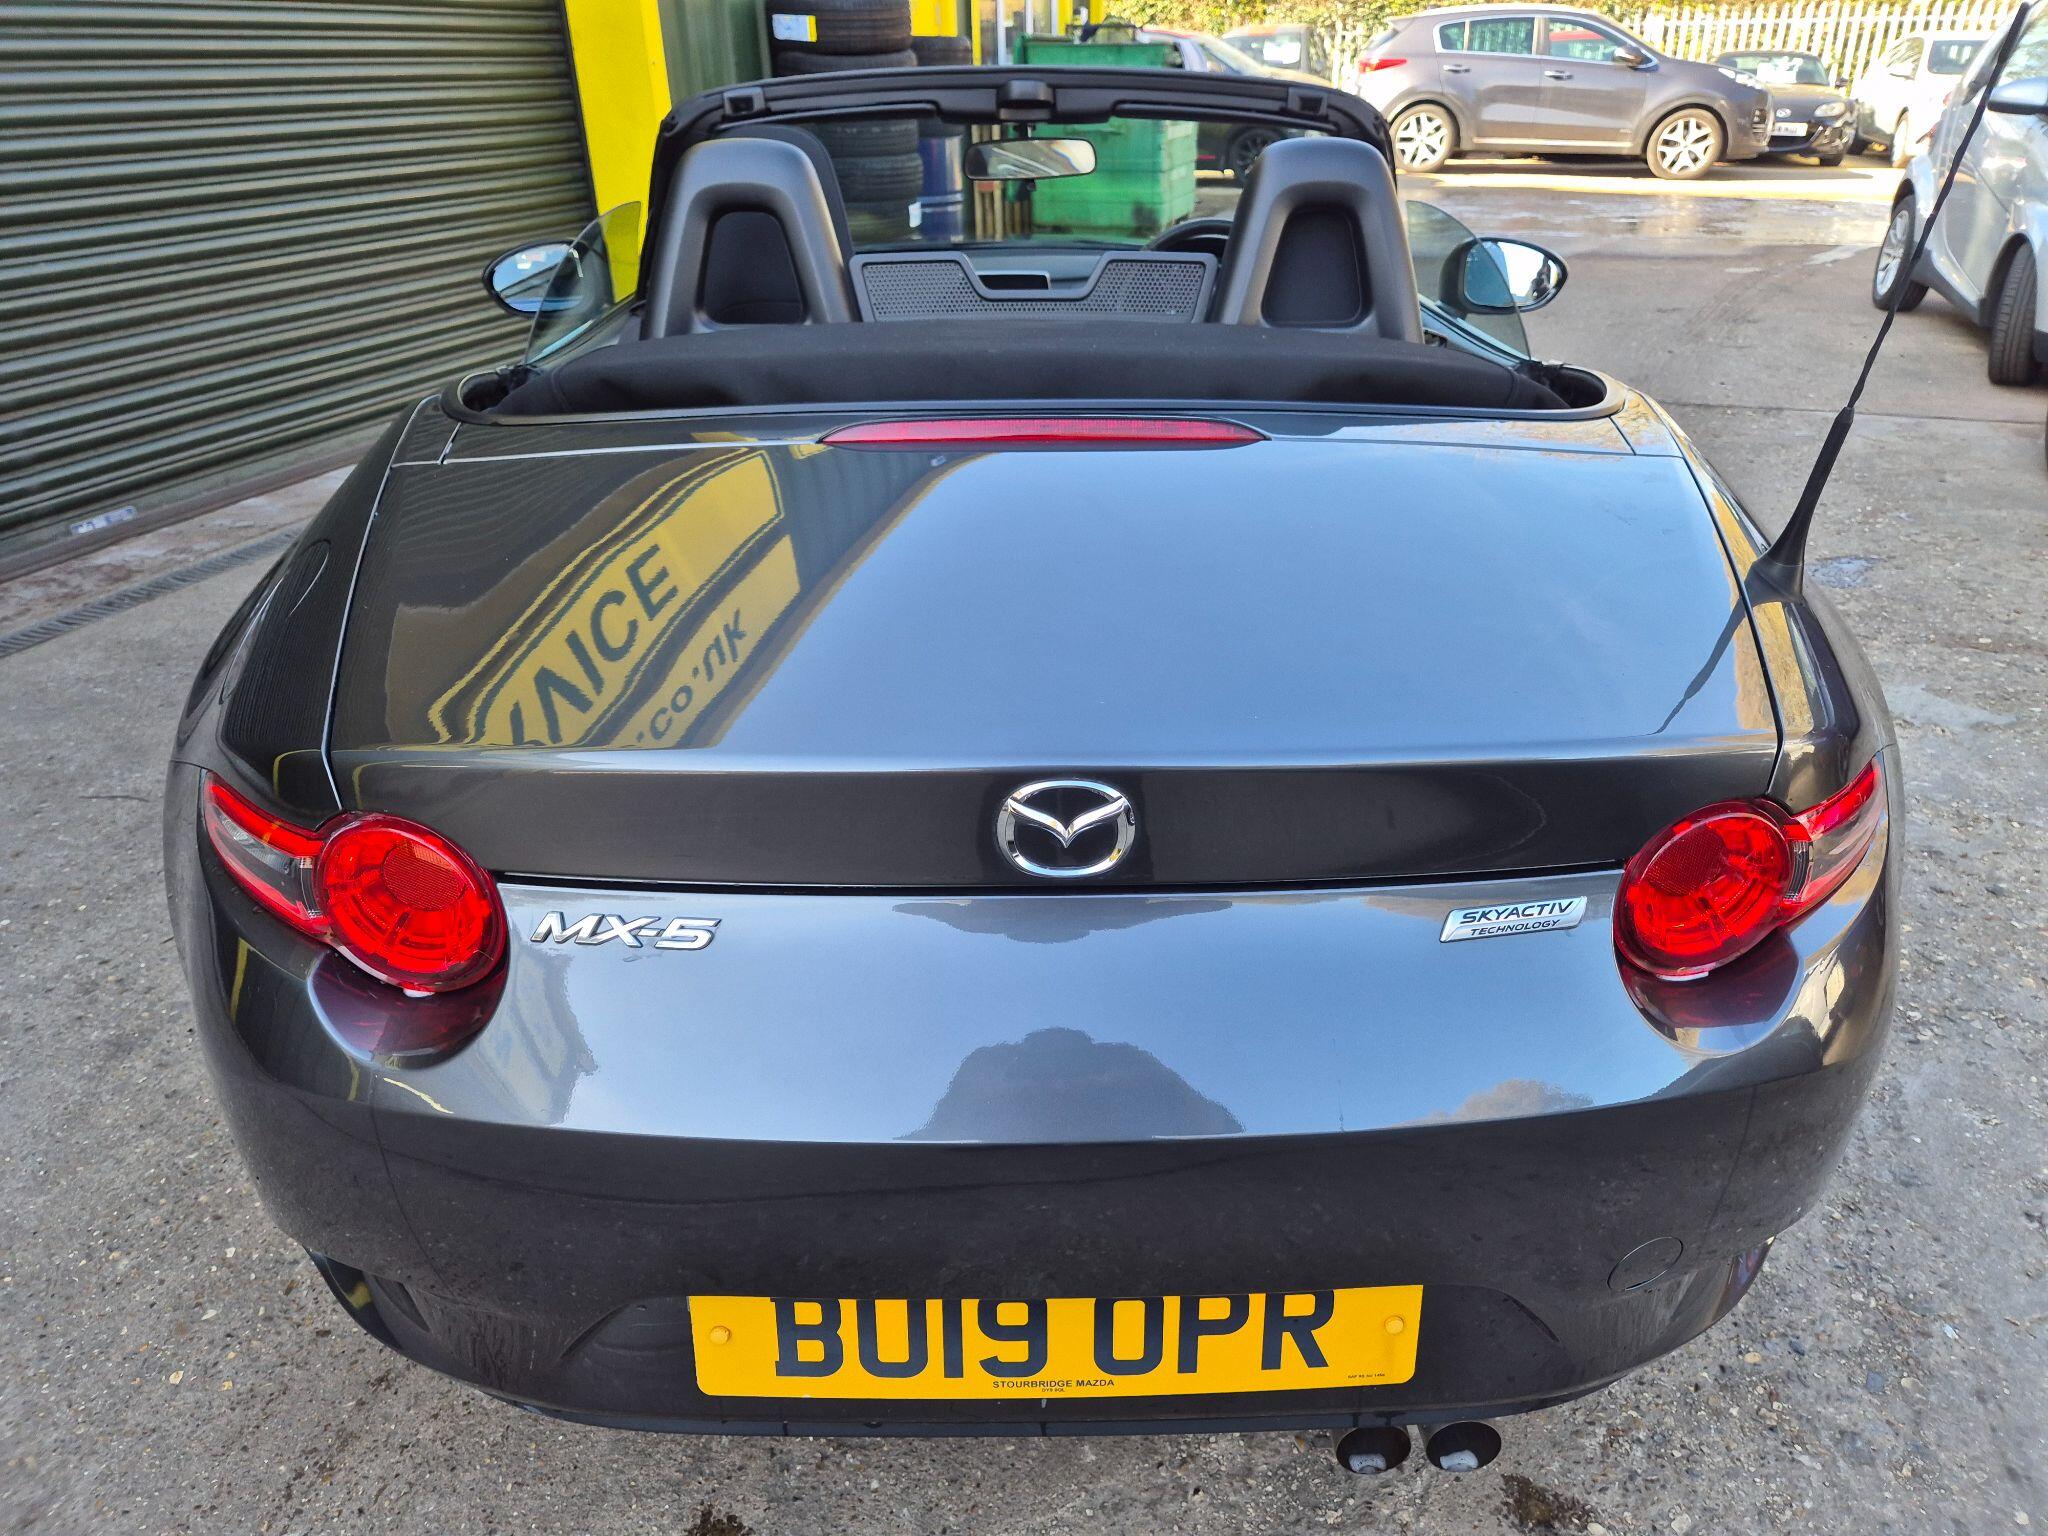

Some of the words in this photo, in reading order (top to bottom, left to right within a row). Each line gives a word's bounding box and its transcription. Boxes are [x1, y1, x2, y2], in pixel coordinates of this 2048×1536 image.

[1460, 900, 1574, 925] SKYACTIV
[529, 910, 723, 951] MX-5
[1470, 919, 1561, 936] TECHNOLOGY
[770, 1297, 1048, 1379] BU19
[1093, 1290, 1335, 1376] OPR
[992, 1379, 1073, 1389] STOURBRIDGE
[1076, 1379, 1115, 1387] MAZDA
